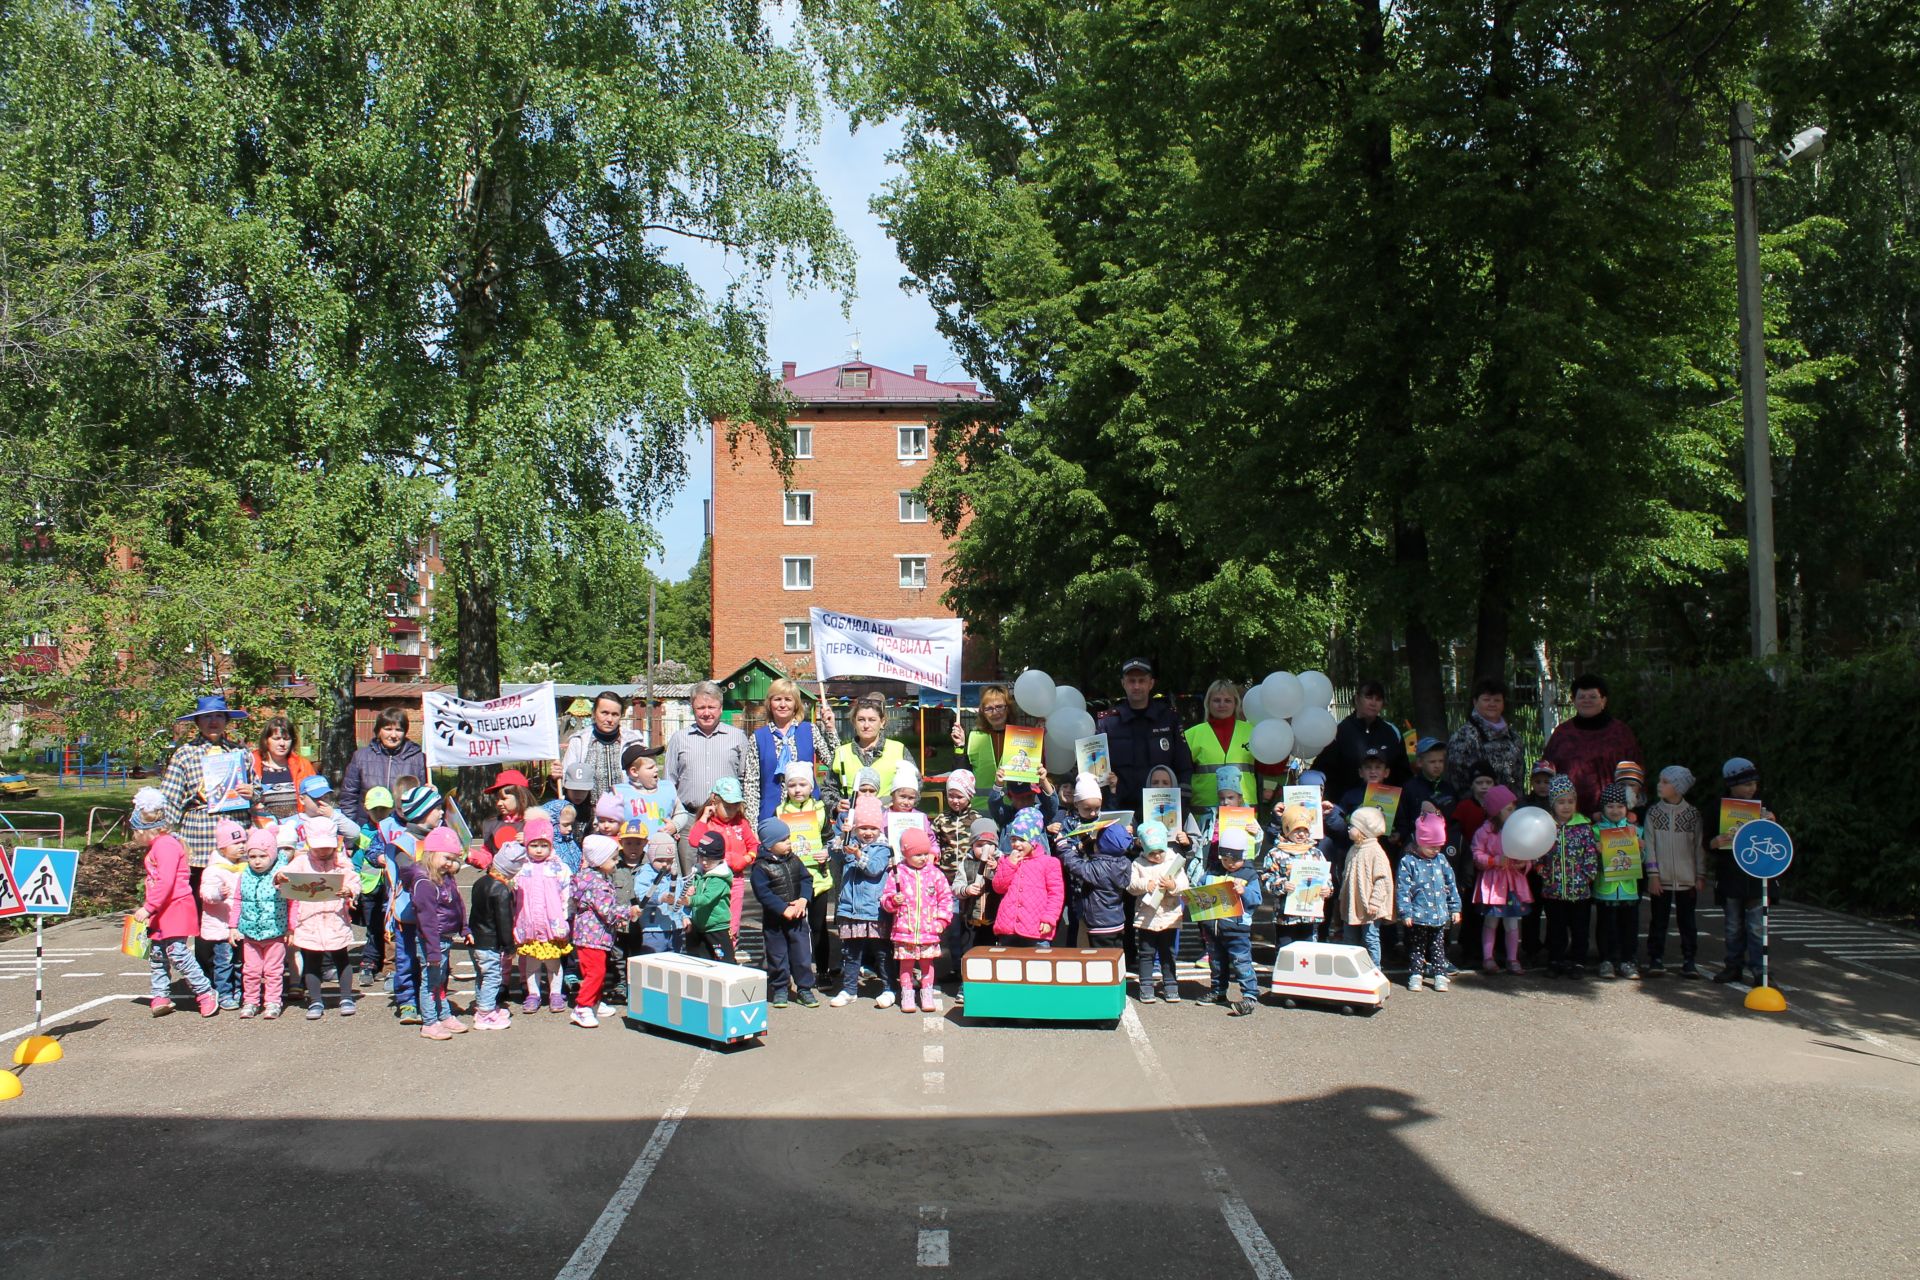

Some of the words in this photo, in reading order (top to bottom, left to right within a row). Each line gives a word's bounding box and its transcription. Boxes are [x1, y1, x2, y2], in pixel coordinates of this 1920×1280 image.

[823, 613, 894, 636] СОБЛЮДАЕМ
[876, 637, 932, 655] ПРАВИЛА
[477, 714, 536, 732] ПЕШЕХОДУ
